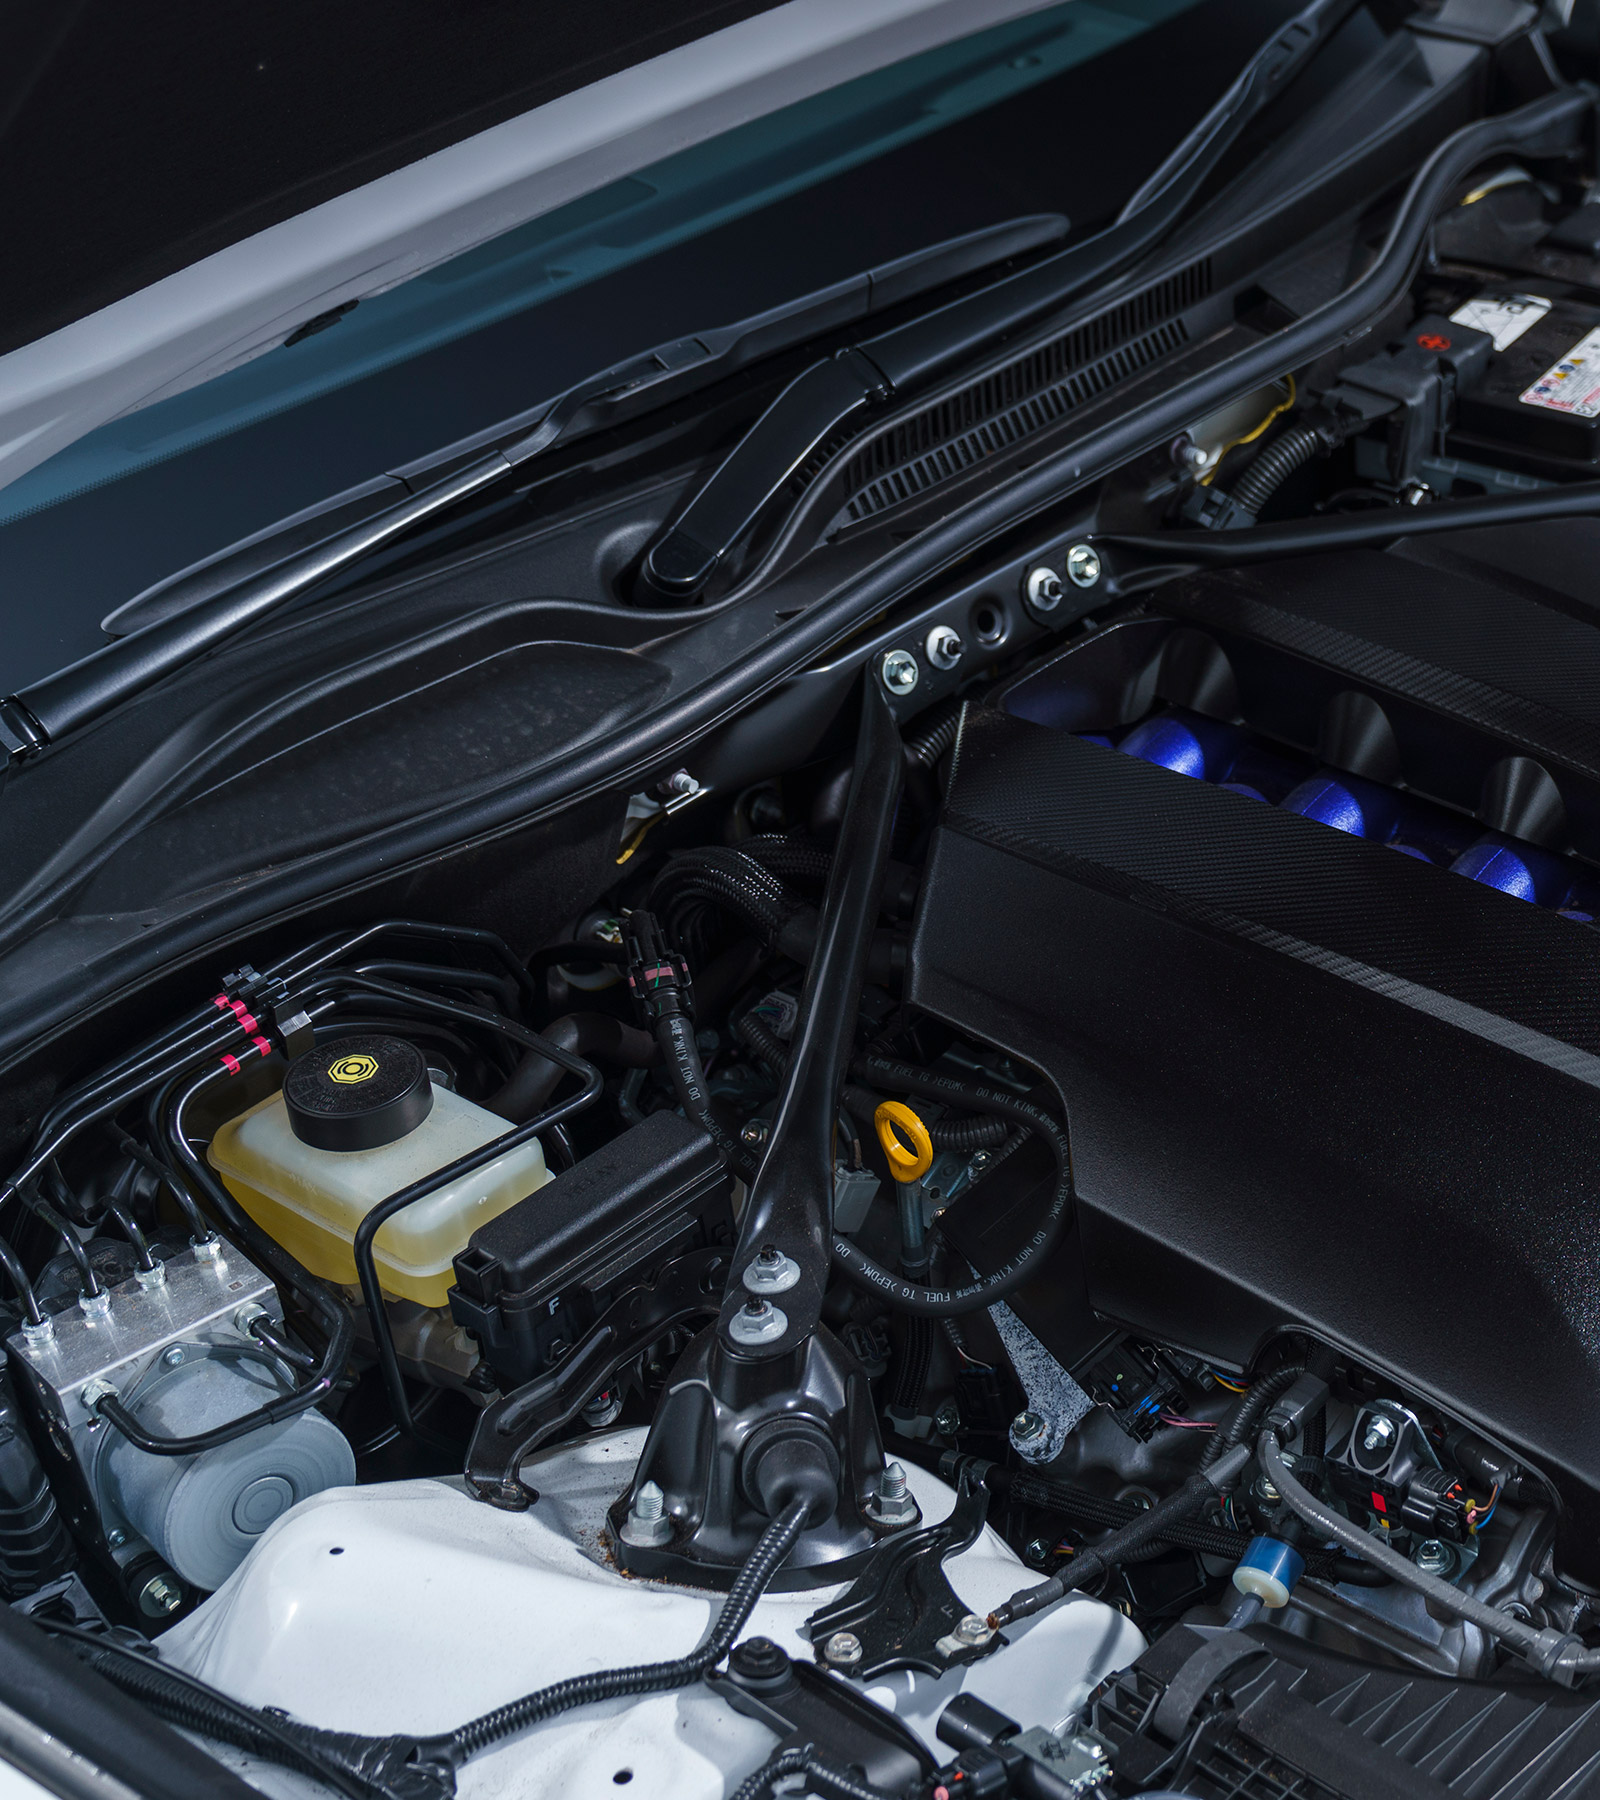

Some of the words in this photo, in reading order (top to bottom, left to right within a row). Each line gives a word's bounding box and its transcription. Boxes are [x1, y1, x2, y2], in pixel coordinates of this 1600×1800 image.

[680, 1066, 695, 1085] NOT
[893, 1064, 915, 1078] FUEL
[919, 1071, 931, 1082] TG
[975, 1087, 990, 1098] DO
[992, 1092, 1013, 1105] NOT
[688, 1086, 701, 1101] DO
[1056, 1134, 1069, 1160] FUEL
[1032, 1230, 1047, 1245] DO
[835, 1242, 851, 1258] DO
[1015, 1246, 1034, 1266] NOT
[901, 1287, 916, 1300] TG
[923, 1291, 951, 1303] FUEL
[548, 1296, 561, 1316] F
